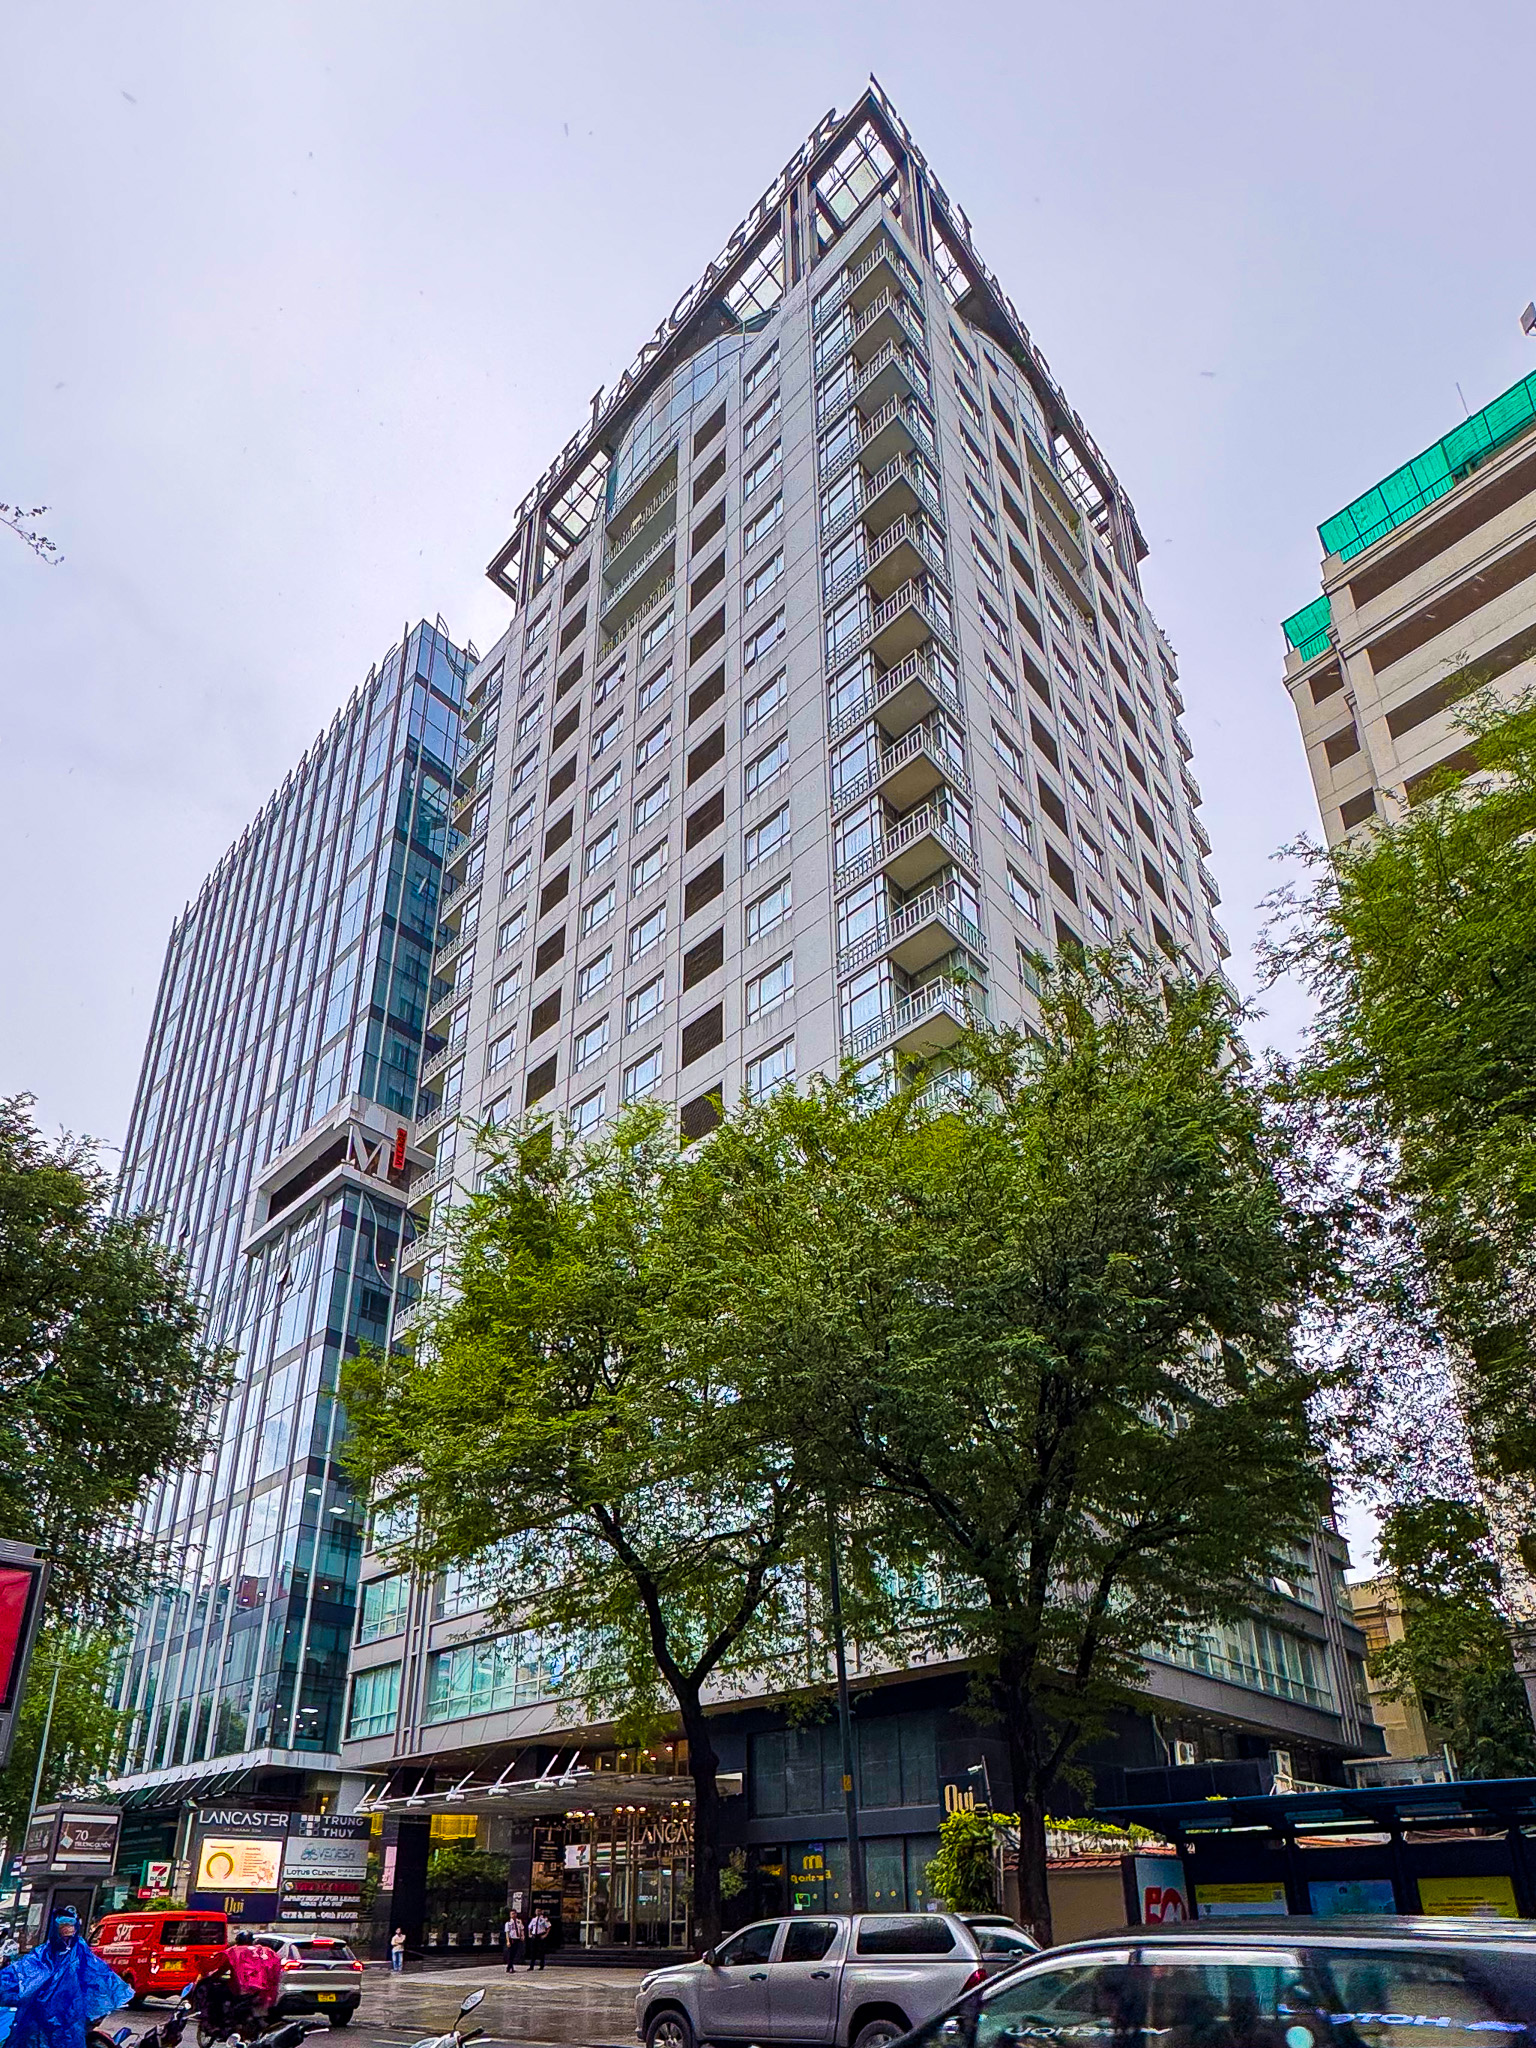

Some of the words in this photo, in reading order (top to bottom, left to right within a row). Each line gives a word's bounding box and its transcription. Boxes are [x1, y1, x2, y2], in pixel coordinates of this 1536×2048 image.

[588, 108, 846, 440] LANCASTER
[341, 1120, 391, 1183] M
[199, 1810, 289, 1827] LANCASTER
[323, 1815, 364, 1827] TRUNG
[75, 1829, 89, 1841] 70
[321, 1827, 355, 1838] THUY
